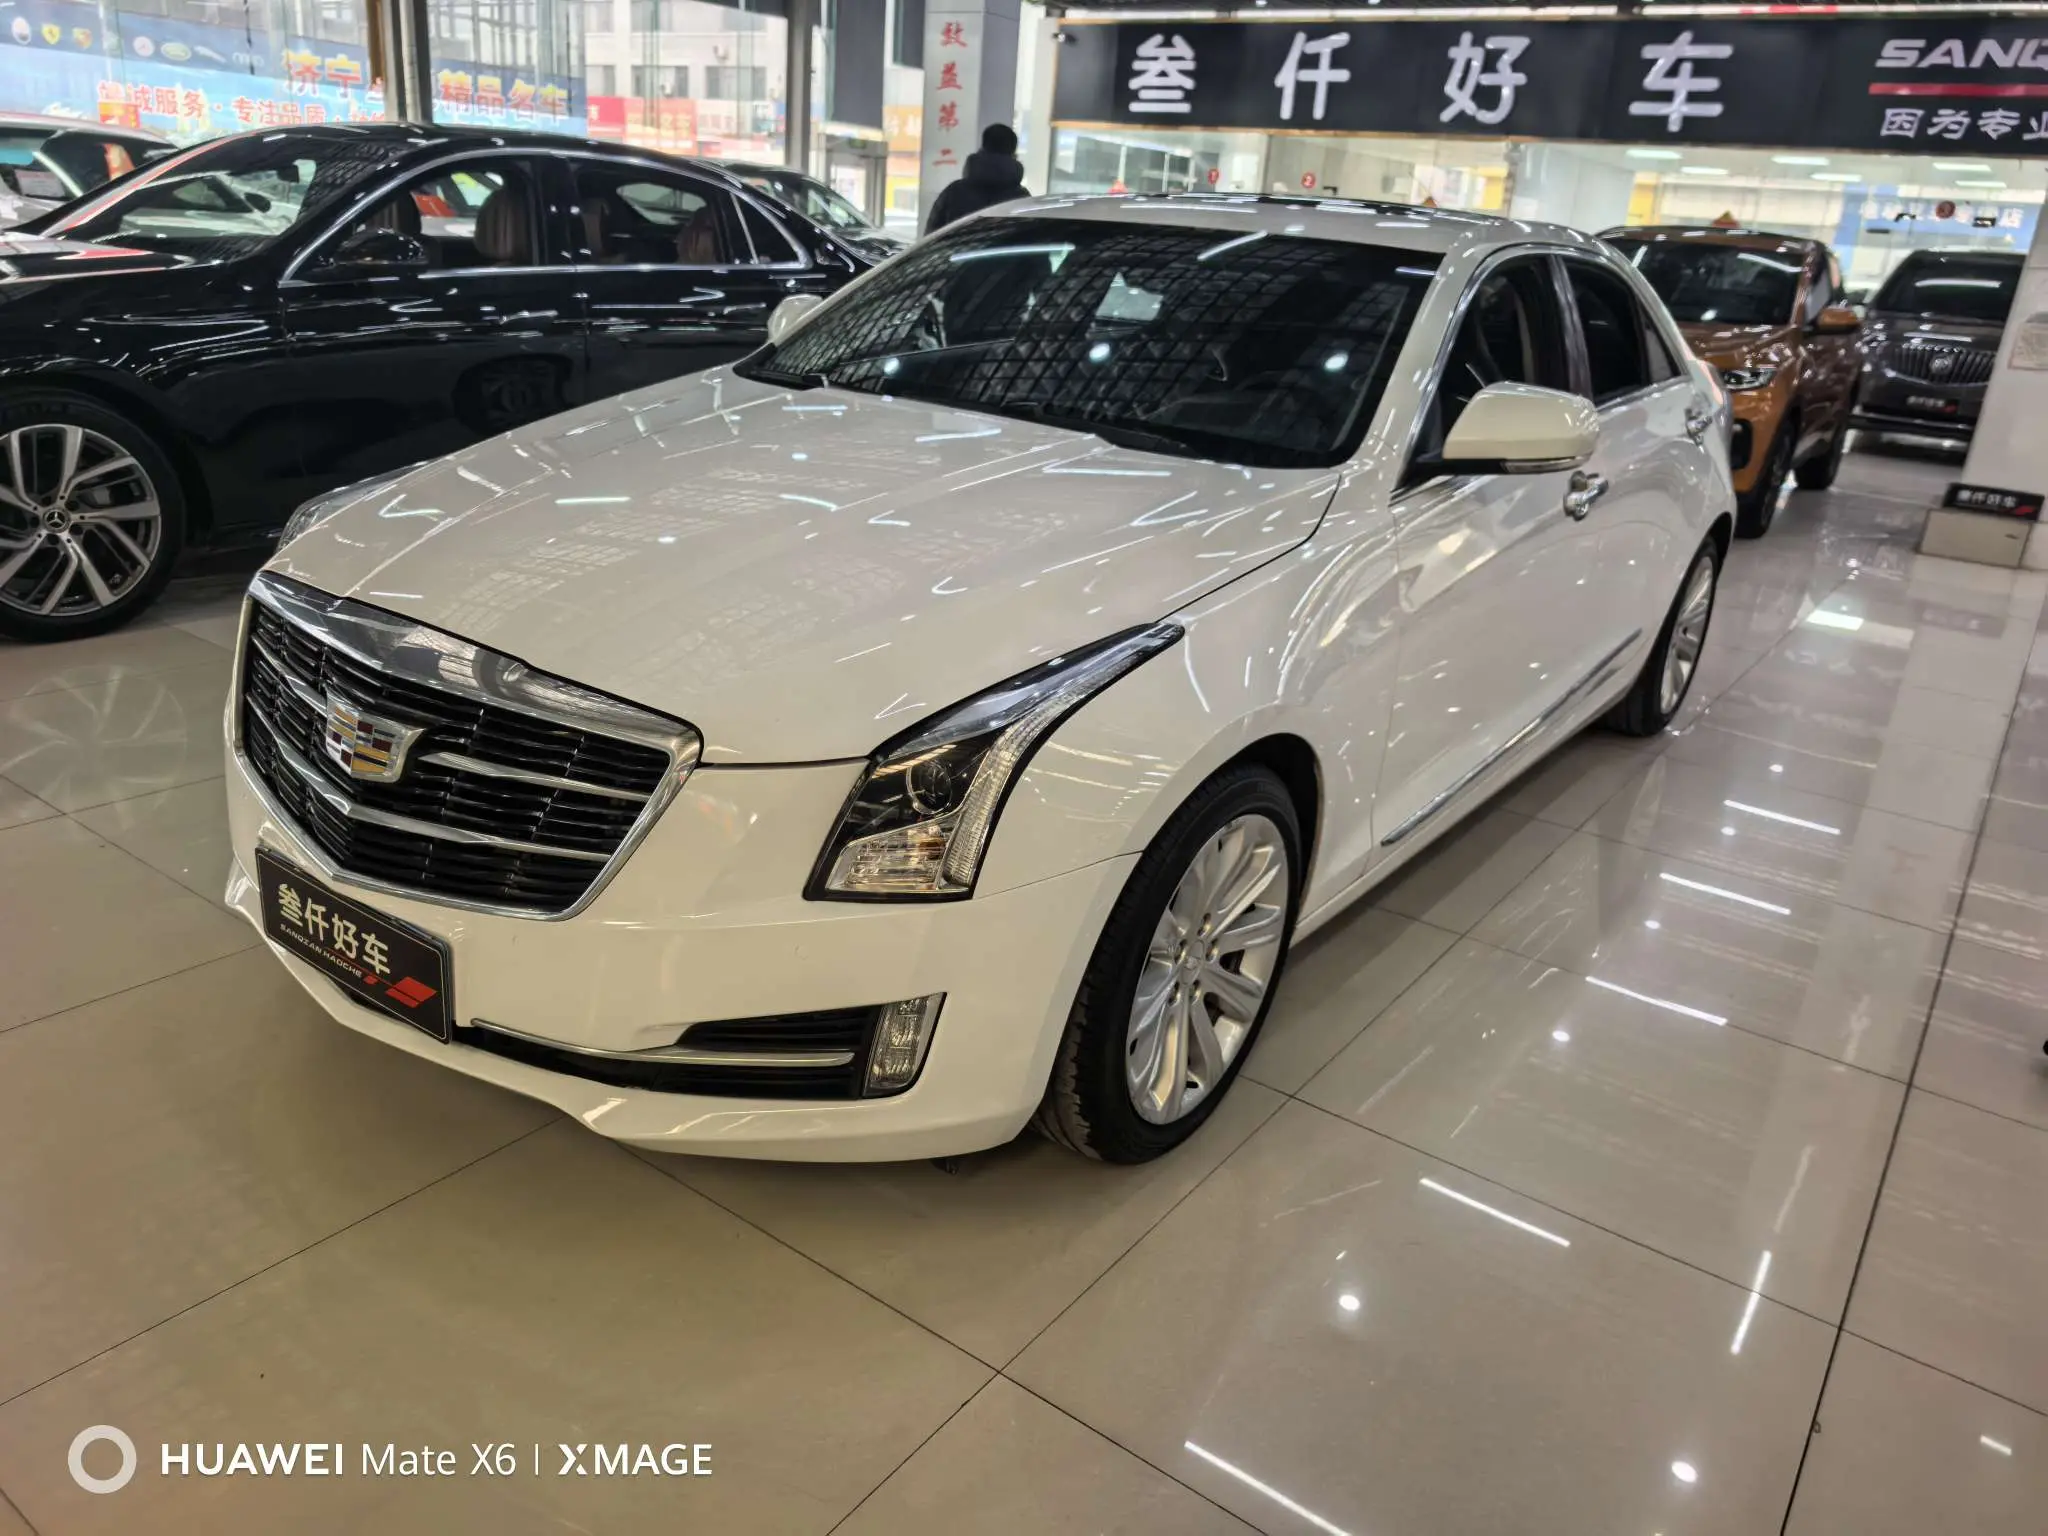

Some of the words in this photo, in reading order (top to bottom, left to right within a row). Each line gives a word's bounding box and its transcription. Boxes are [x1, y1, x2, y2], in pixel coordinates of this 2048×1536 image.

[1128, 31, 1733, 132] 叁仟好车
[279, 884, 390, 974] 叁仟好车
